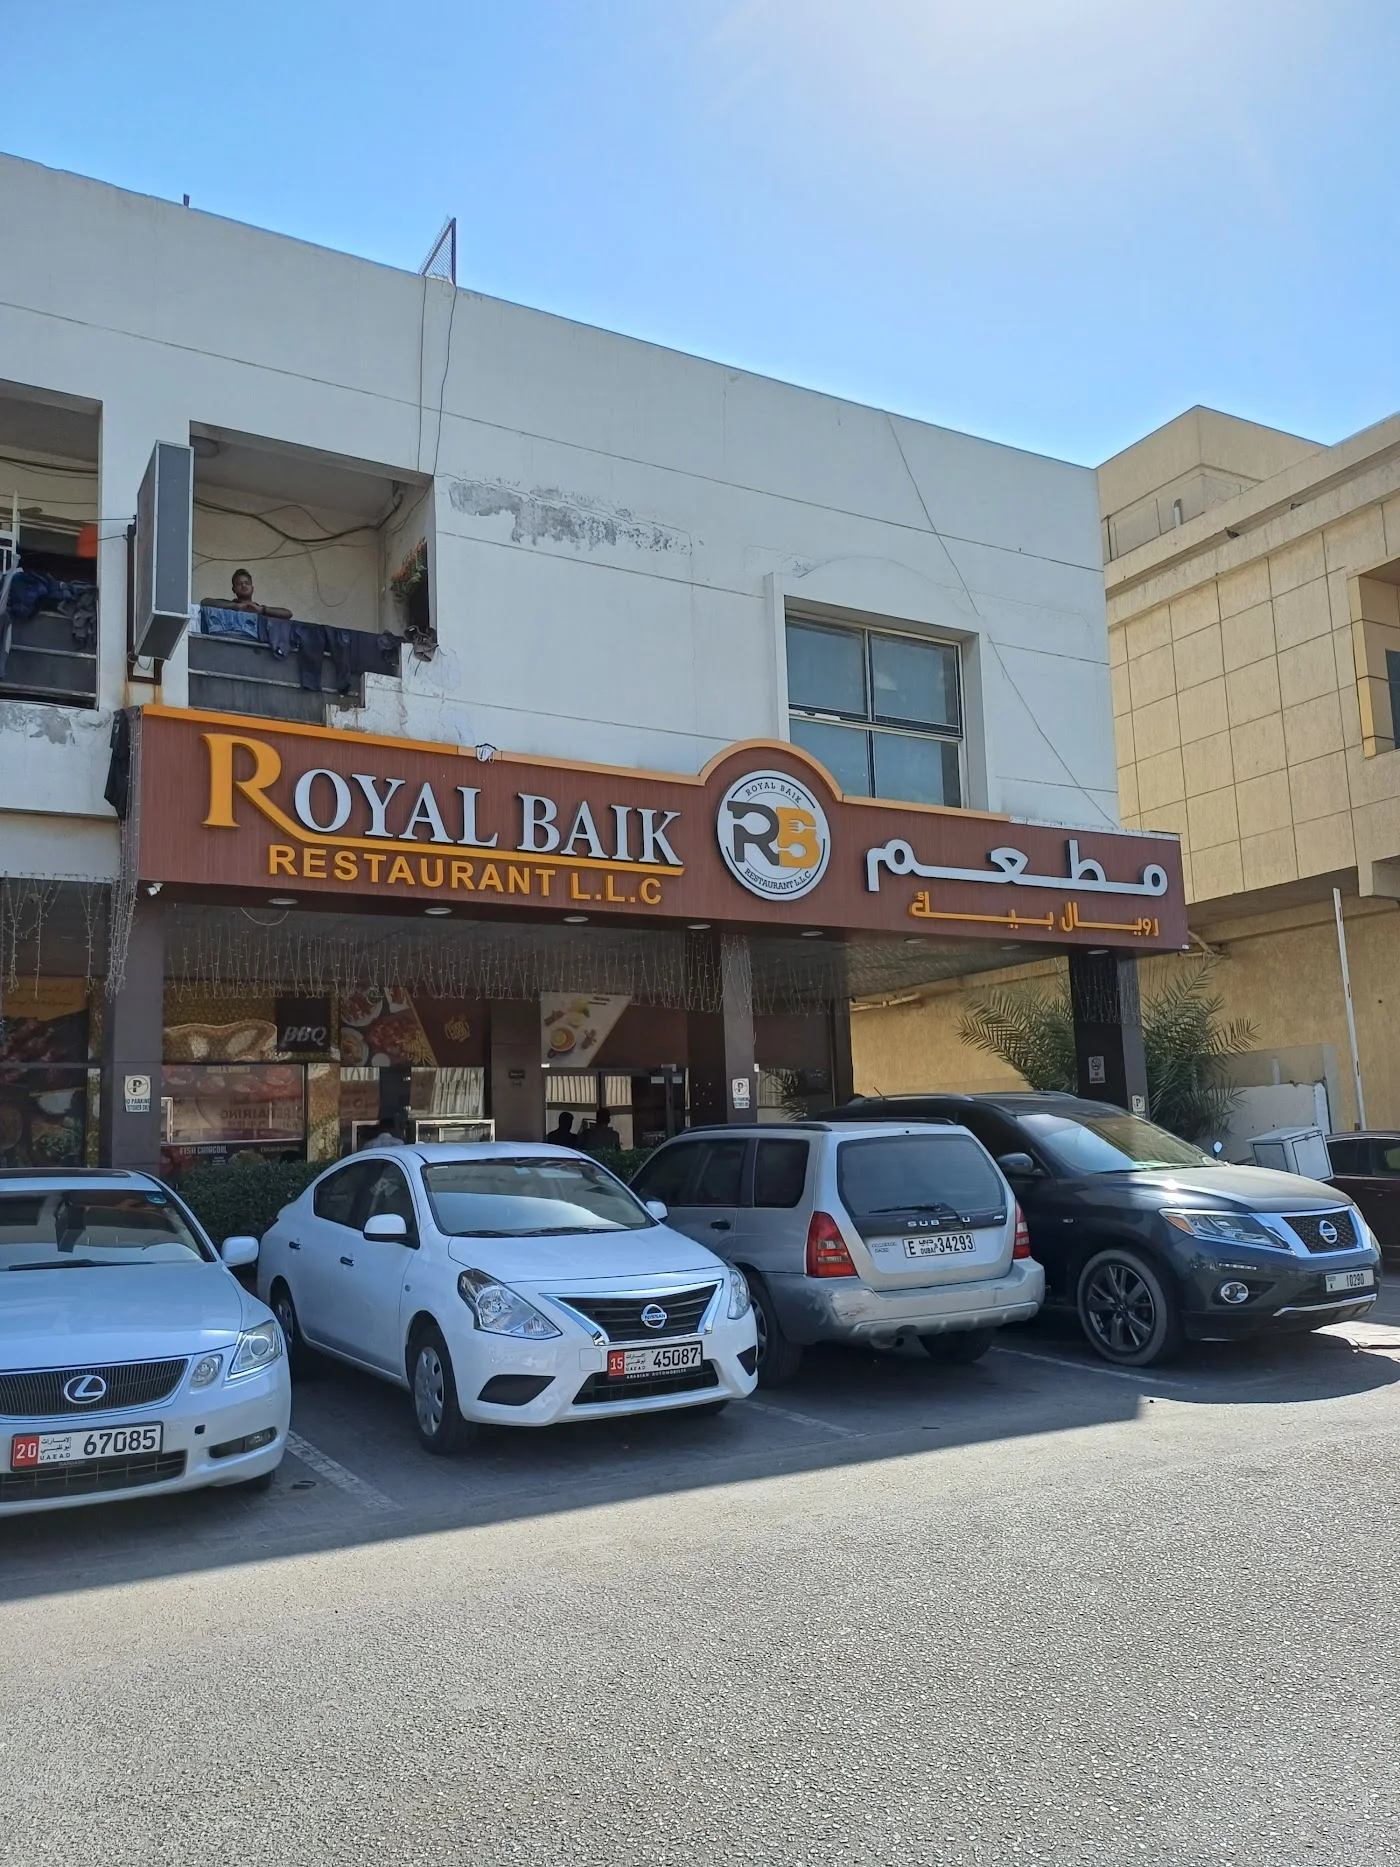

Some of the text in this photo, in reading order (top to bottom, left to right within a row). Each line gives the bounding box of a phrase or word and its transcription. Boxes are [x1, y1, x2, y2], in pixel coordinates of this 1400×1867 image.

[201, 733, 683, 866] ROYAL BAIK
[745, 782, 802, 803] ROYAL BAIK
[268, 843, 663, 905] RESTAURANT L.L.C
[744, 868, 794, 890] RESTAURANT
[281, 1026, 327, 1047] BBQ
[907, 1240, 917, 1256] E
[920, 1247, 936, 1255] DUBAI
[938, 1234, 974, 1253] 34293
[610, 1357, 624, 1371] 15
[653, 1347, 699, 1368] 45087
[16, 1442, 37, 1460] 20
[83, 1428, 157, 1456] 67085
